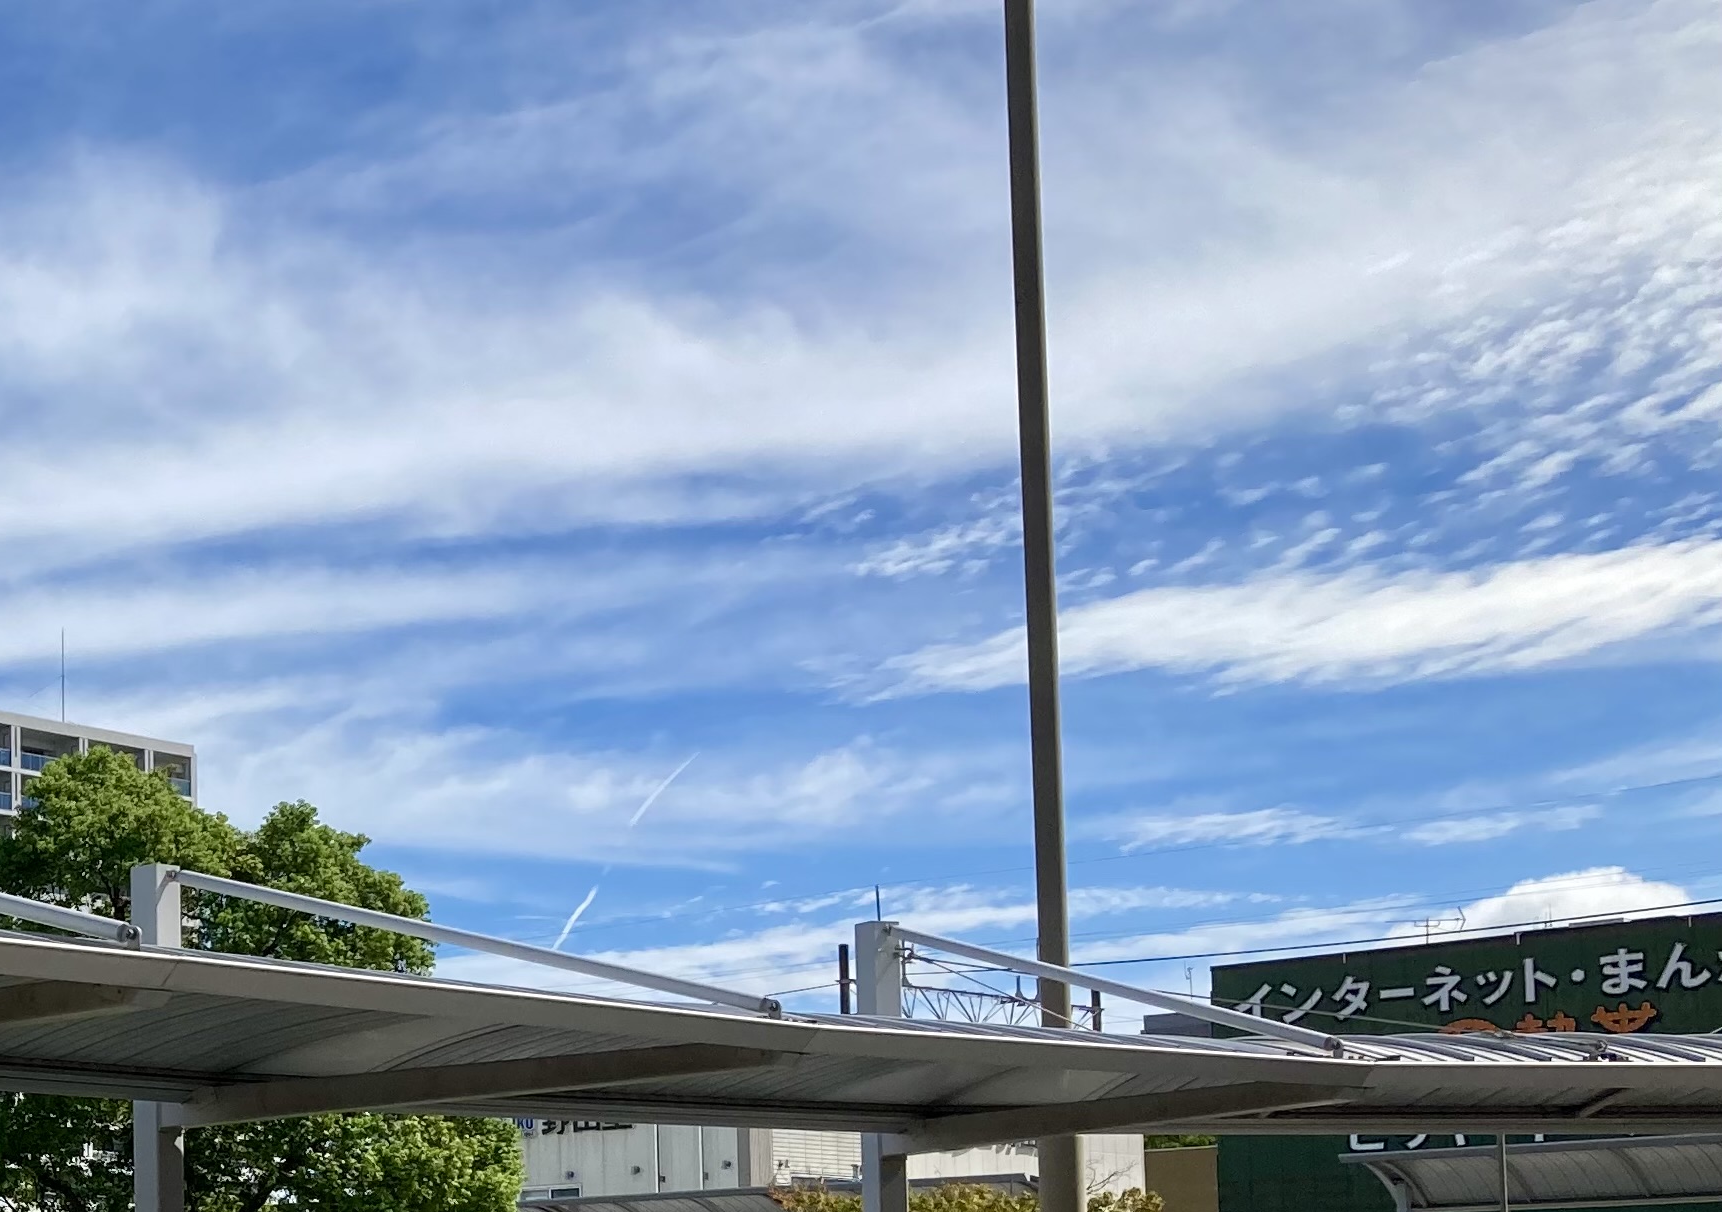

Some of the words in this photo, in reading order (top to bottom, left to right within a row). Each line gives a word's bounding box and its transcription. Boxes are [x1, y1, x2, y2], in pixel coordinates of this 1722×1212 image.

[1235, 941, 1722, 1024] インターネット・まん
